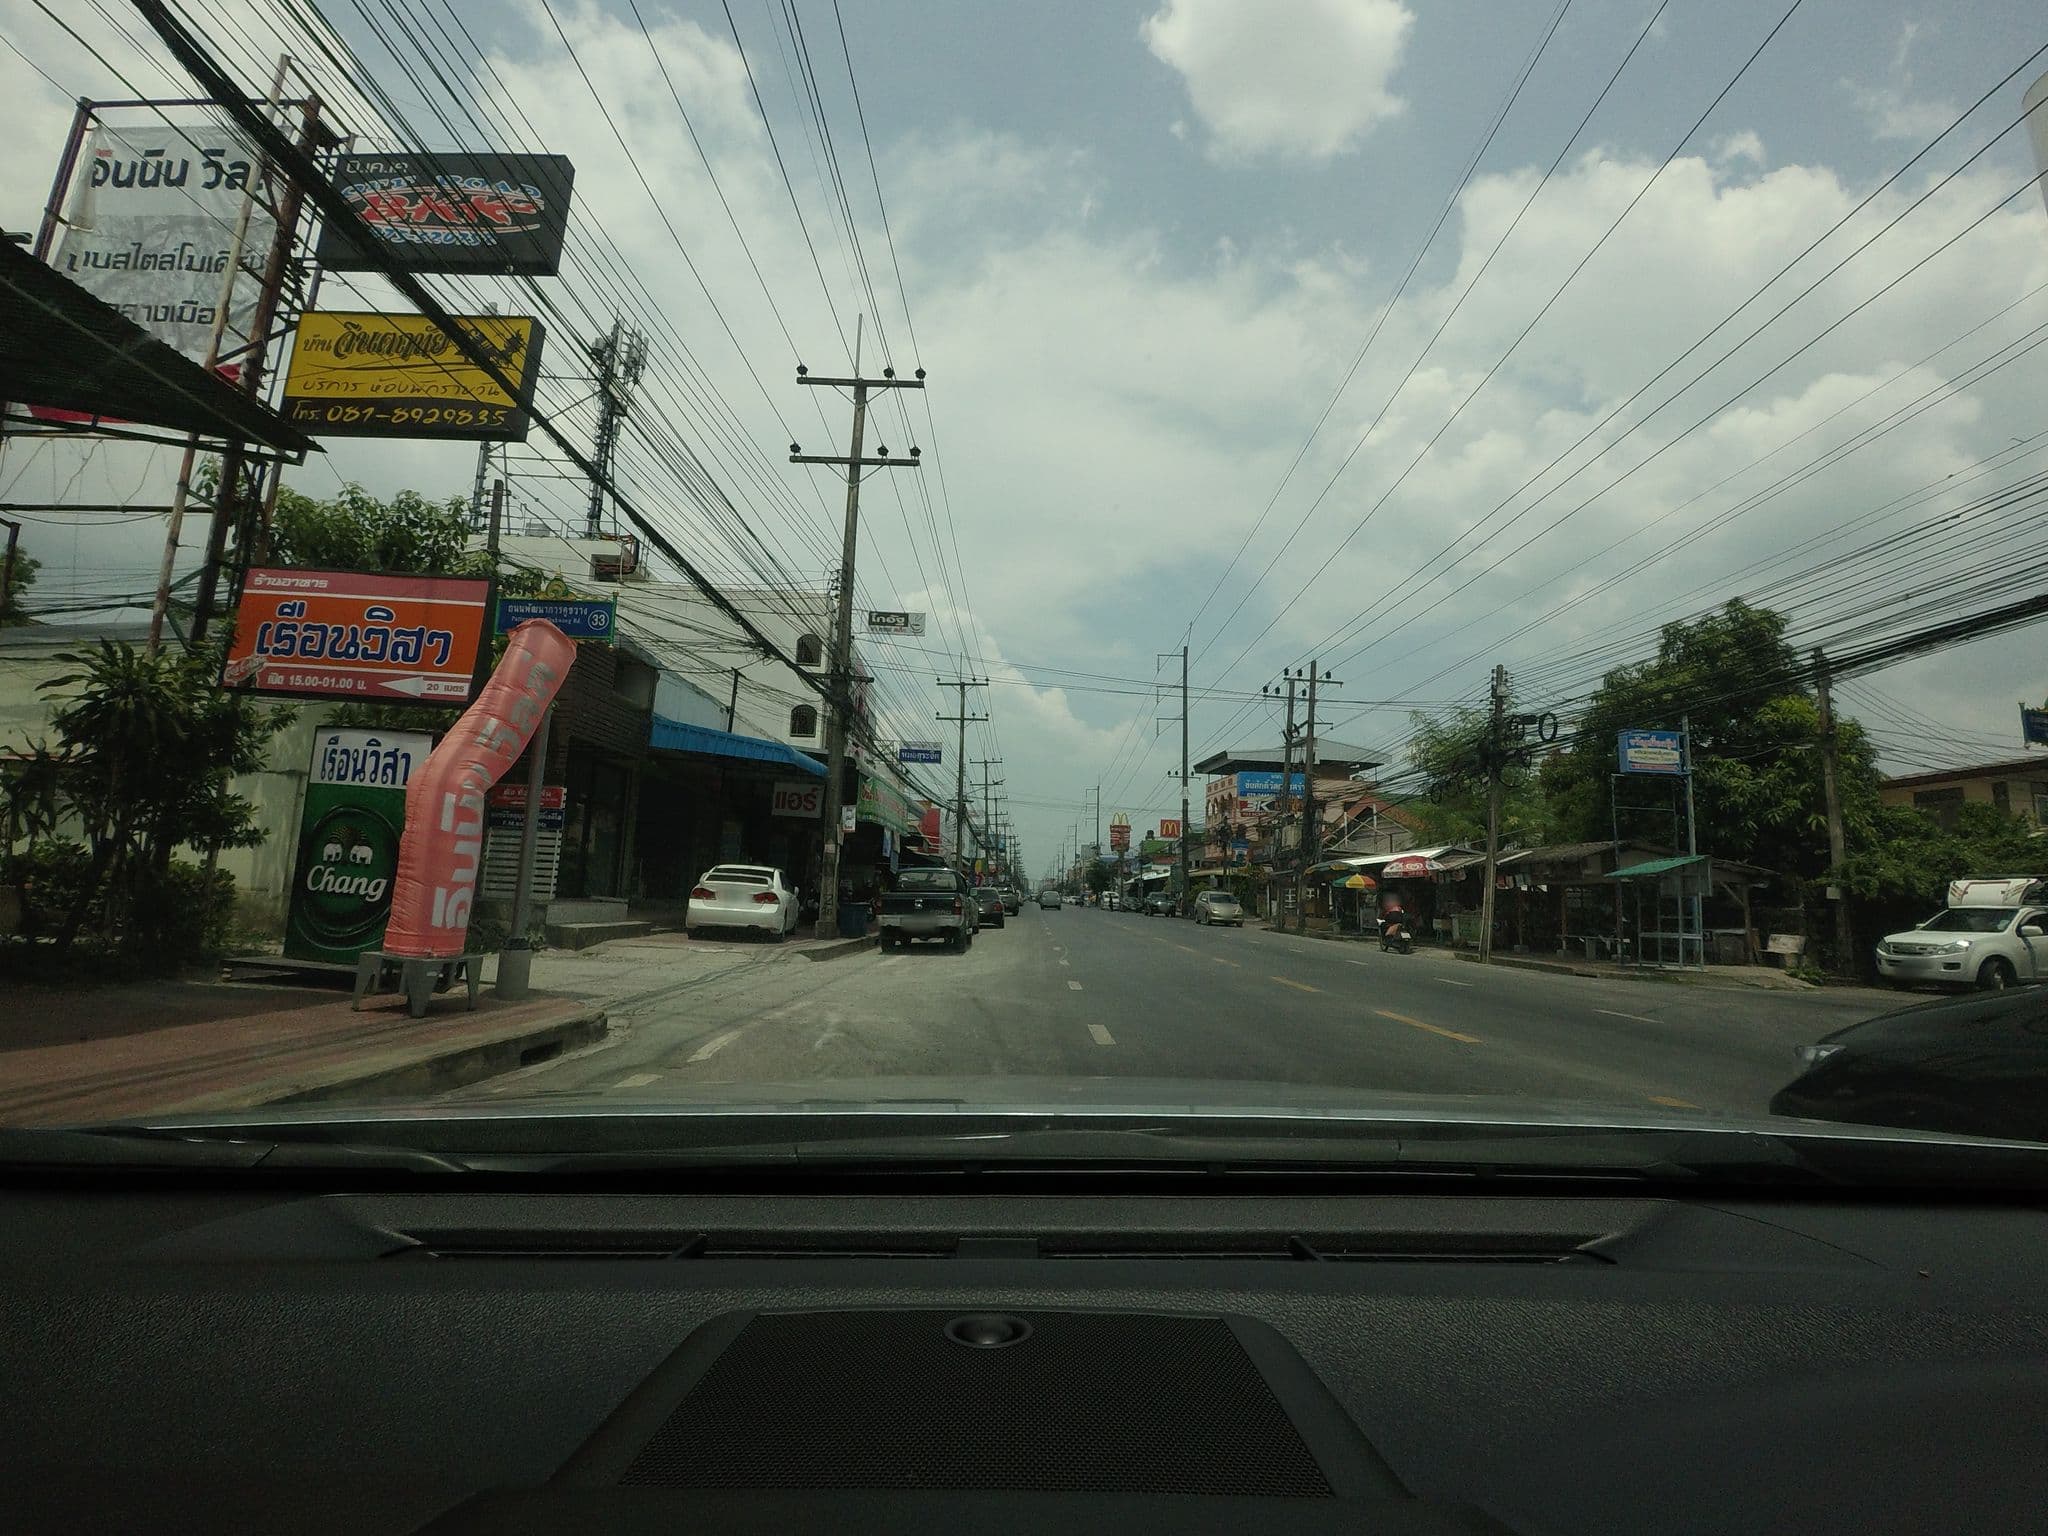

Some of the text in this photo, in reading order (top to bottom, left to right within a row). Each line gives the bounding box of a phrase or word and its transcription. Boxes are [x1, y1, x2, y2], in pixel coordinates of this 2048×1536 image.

[360, 193, 538, 225] BKK
[303, 377, 364, 391] บริการ
[327, 405, 508, 426] 081-8929835
[254, 573, 329, 588] ร้านอาหาร
[591, 615, 606, 626] 33
[256, 601, 455, 667] เรือนวิสา
[288, 675, 353, 690] 15.00-01.00
[426, 683, 465, 693] 20 เมตร
[320, 735, 412, 786] เรือนวิสา
[307, 865, 388, 902] Chang
